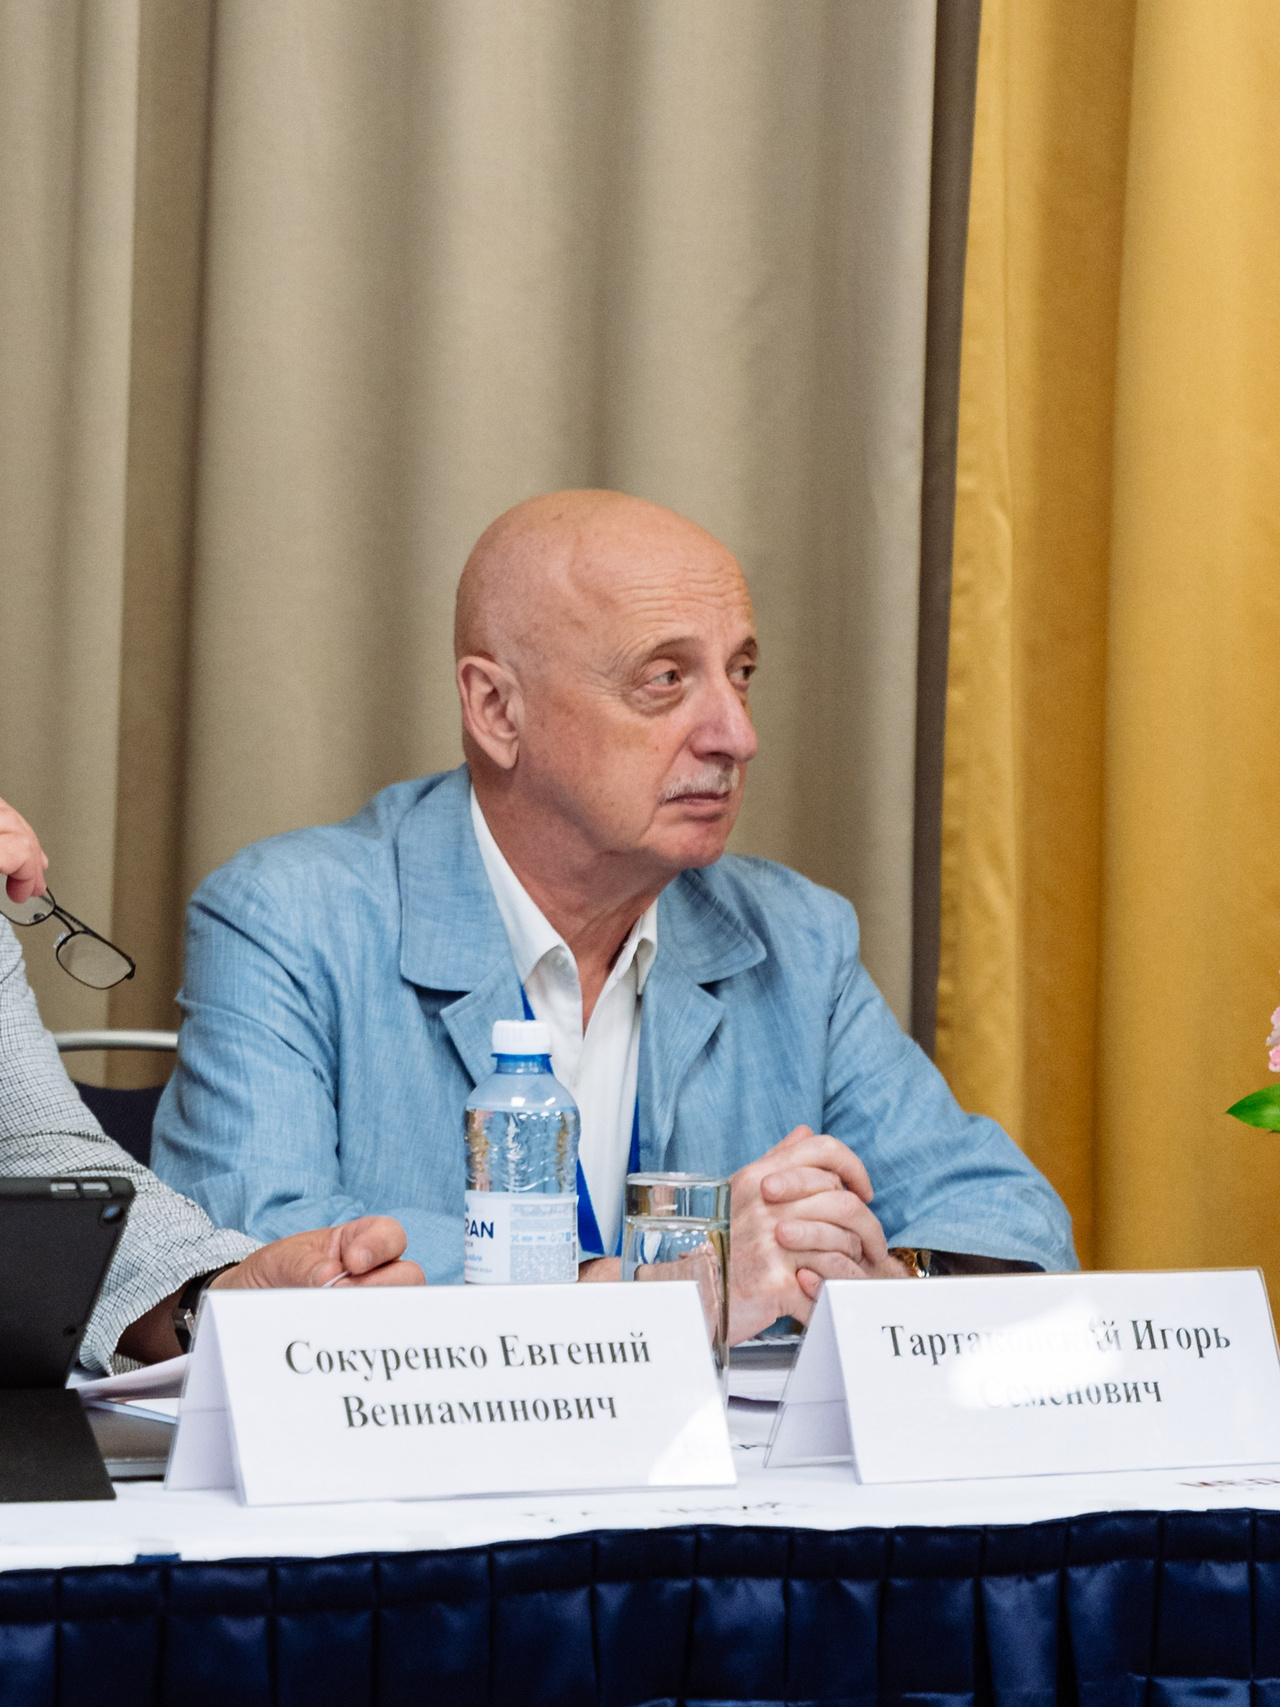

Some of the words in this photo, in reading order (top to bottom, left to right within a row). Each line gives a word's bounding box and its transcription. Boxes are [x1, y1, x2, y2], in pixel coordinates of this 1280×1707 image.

[285, 1340, 488, 1381] Сокуренко
[500, 1332, 651, 1368] Евгений
[1130, 1319, 1231, 1358] Игорь
[343, 1394, 618, 1428] Вениаминович
